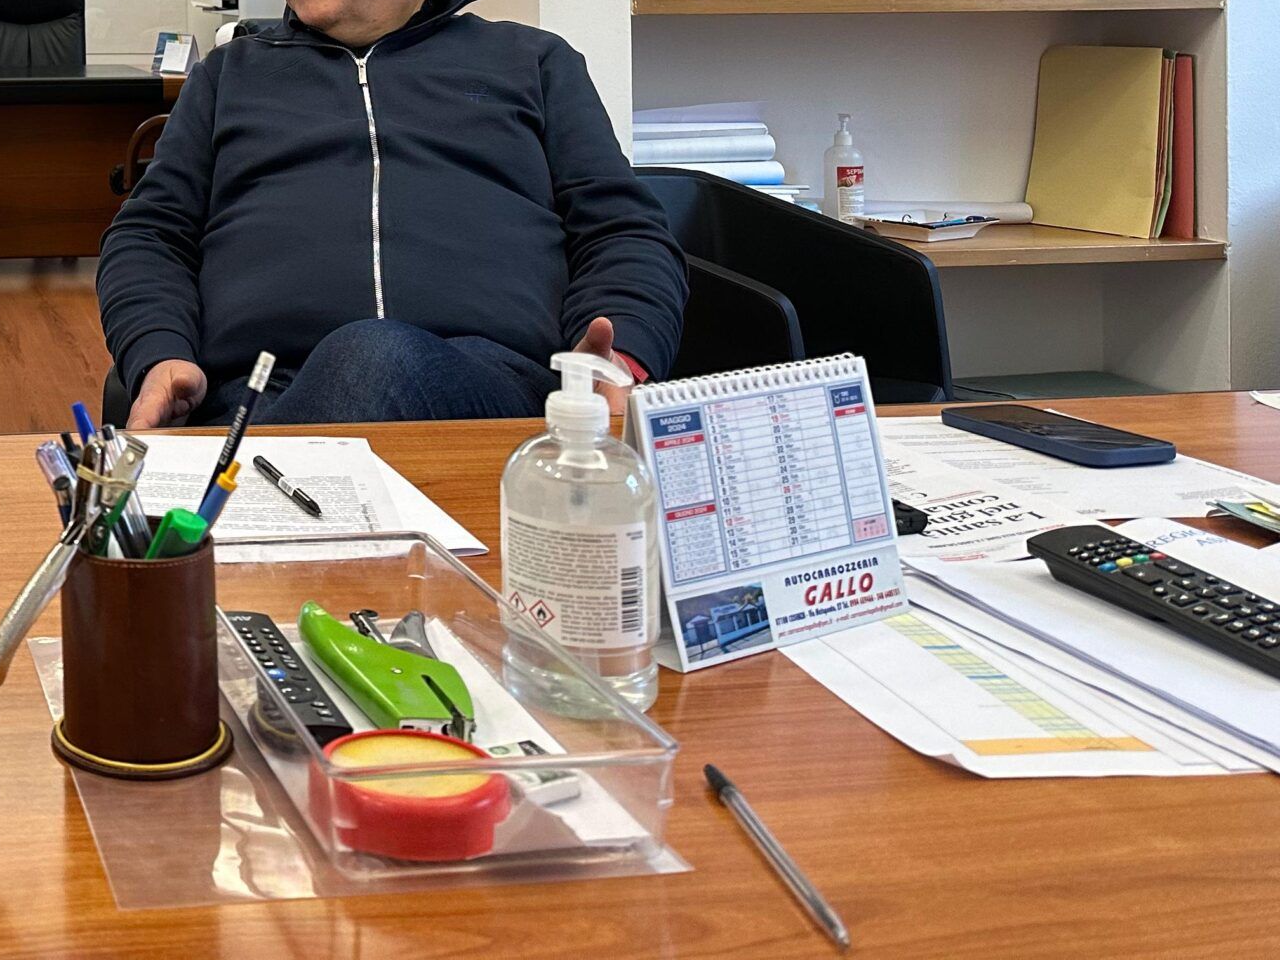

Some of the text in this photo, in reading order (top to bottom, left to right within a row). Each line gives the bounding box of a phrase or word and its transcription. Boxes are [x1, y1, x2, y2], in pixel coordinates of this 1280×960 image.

[659, 414, 692, 426] MAGGIO
[667, 424, 688, 433] 2024
[1006, 510, 1046, 521] La
[784, 557, 879, 587] AUTOCARROZZERIA
[804, 572, 874, 607] GALLO
